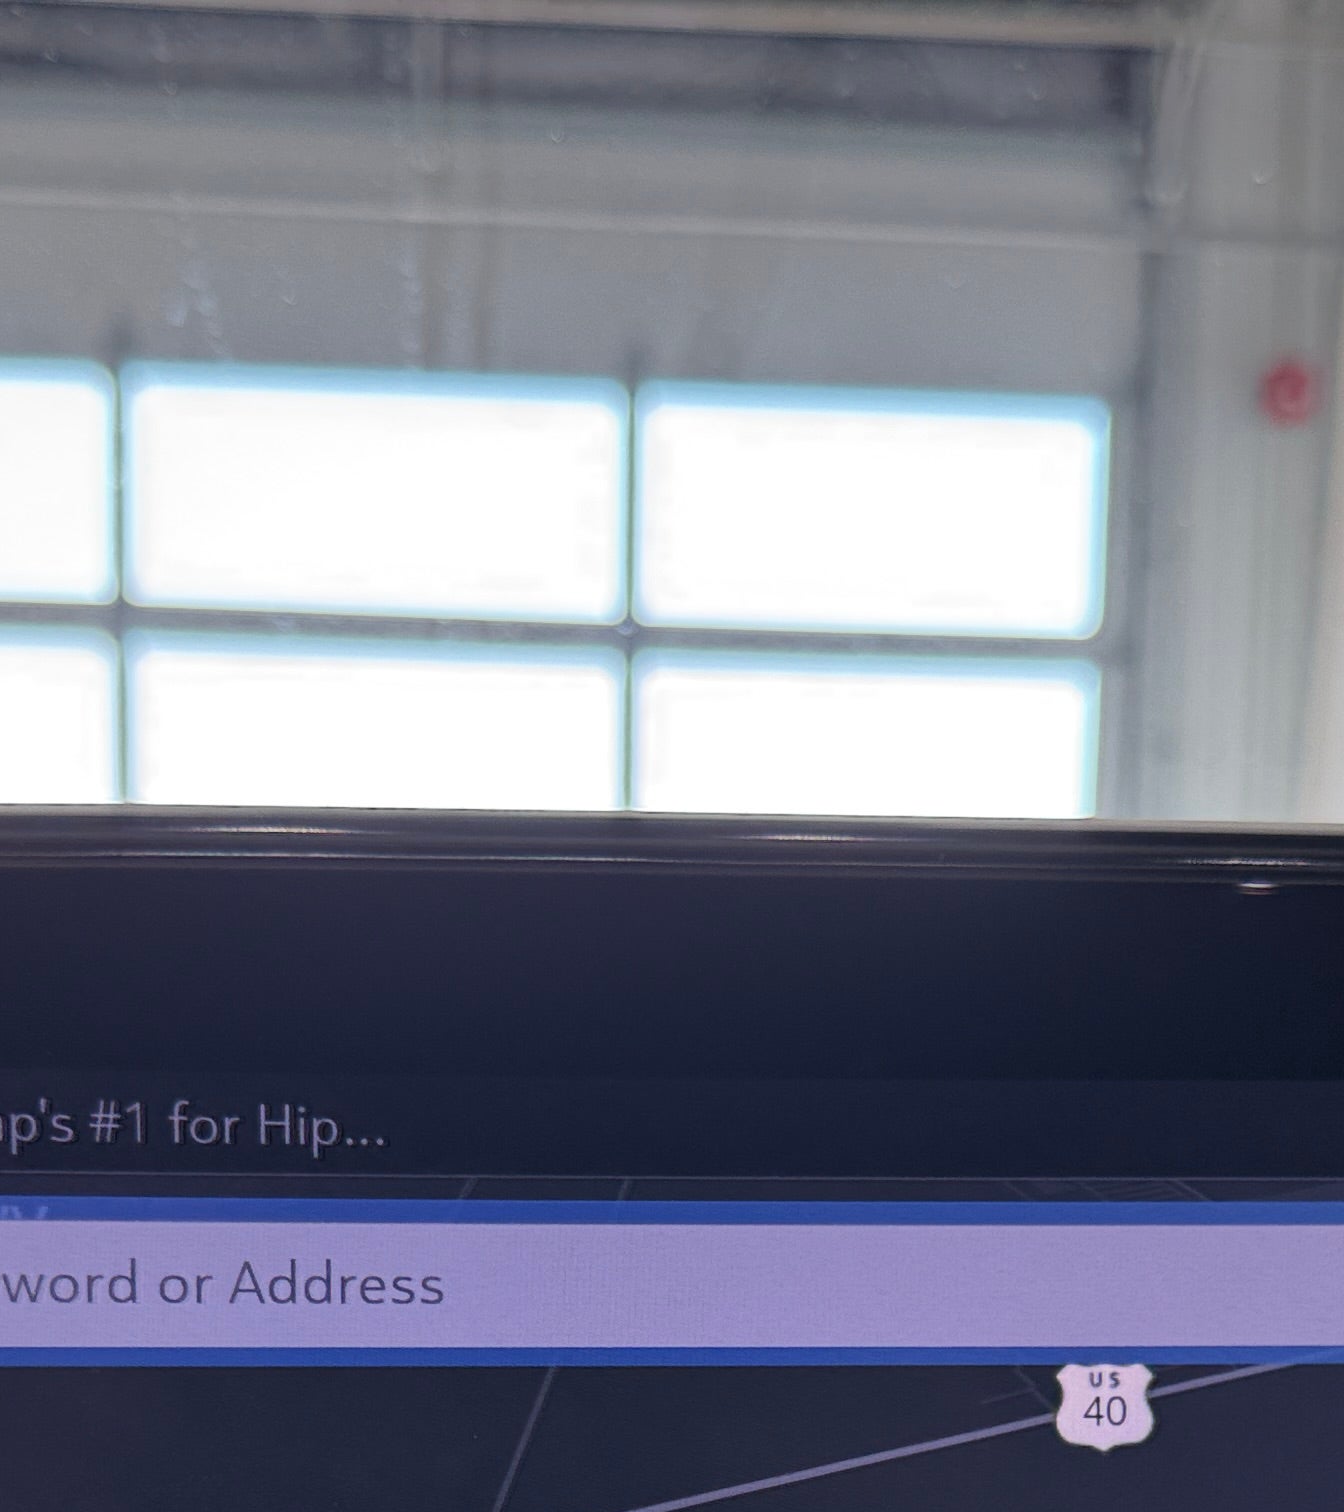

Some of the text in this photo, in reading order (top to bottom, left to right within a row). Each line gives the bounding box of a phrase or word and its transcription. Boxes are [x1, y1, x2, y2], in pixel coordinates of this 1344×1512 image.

[89, 1099, 146, 1143] #1
[168, 1099, 240, 1145] for
[259, 1103, 386, 1159] Hip...
[158, 1273, 215, 1305] or
[228, 1258, 445, 1306] Address
[1089, 1371, 1121, 1389] US
[1083, 1395, 1127, 1427] 40
